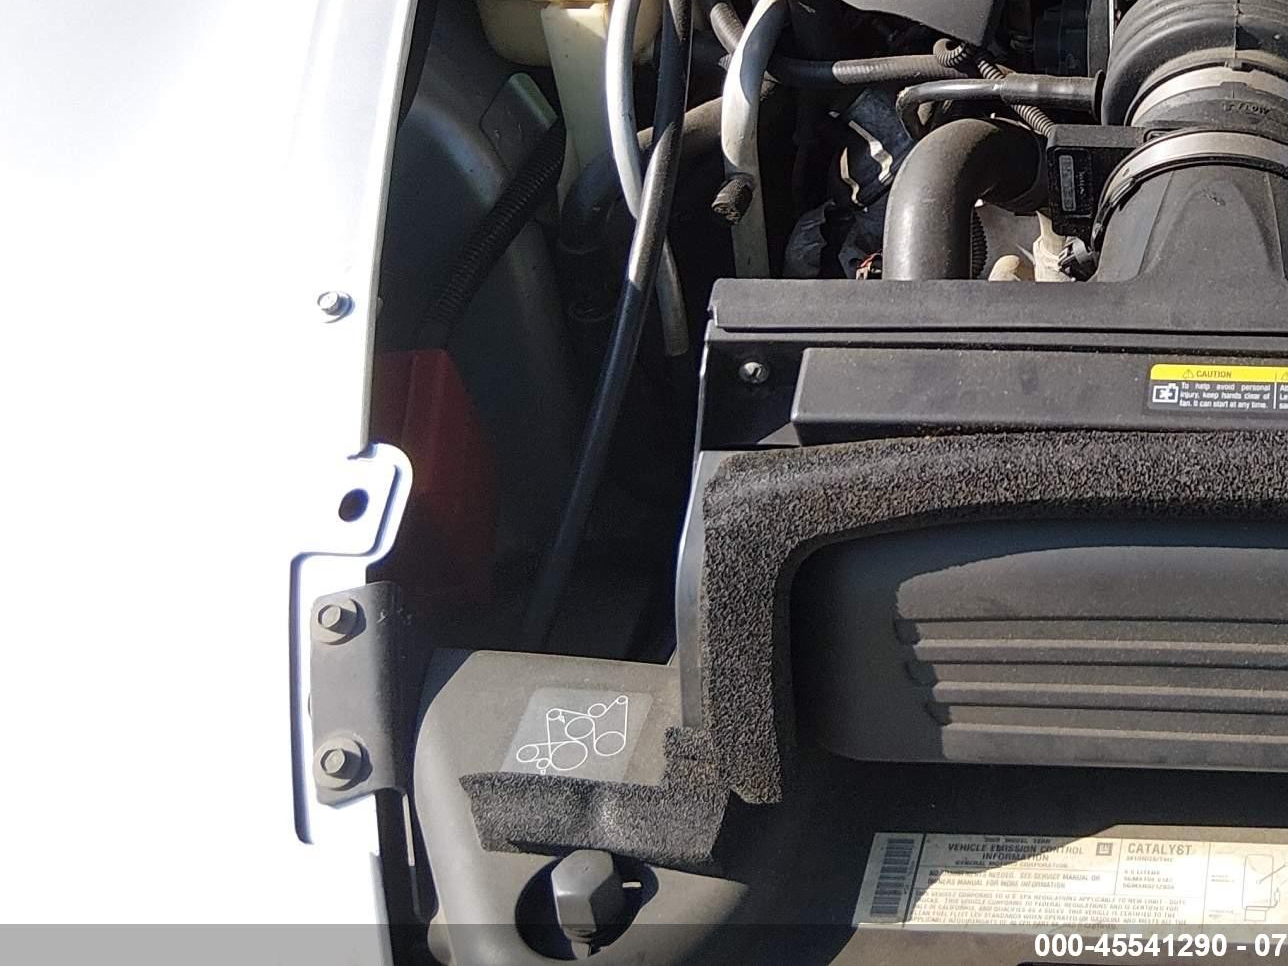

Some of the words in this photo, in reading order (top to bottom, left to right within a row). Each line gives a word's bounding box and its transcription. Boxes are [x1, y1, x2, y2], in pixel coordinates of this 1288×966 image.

[1196, 370, 1232, 378] CAUTION
[1202, 392, 1219, 400] keep
[948, 843, 985, 852] VEHICLE
[991, 843, 1037, 854] EMISSION
[1040, 845, 1085, 855] CONTROL
[1128, 843, 1192, 855] CATALYST
